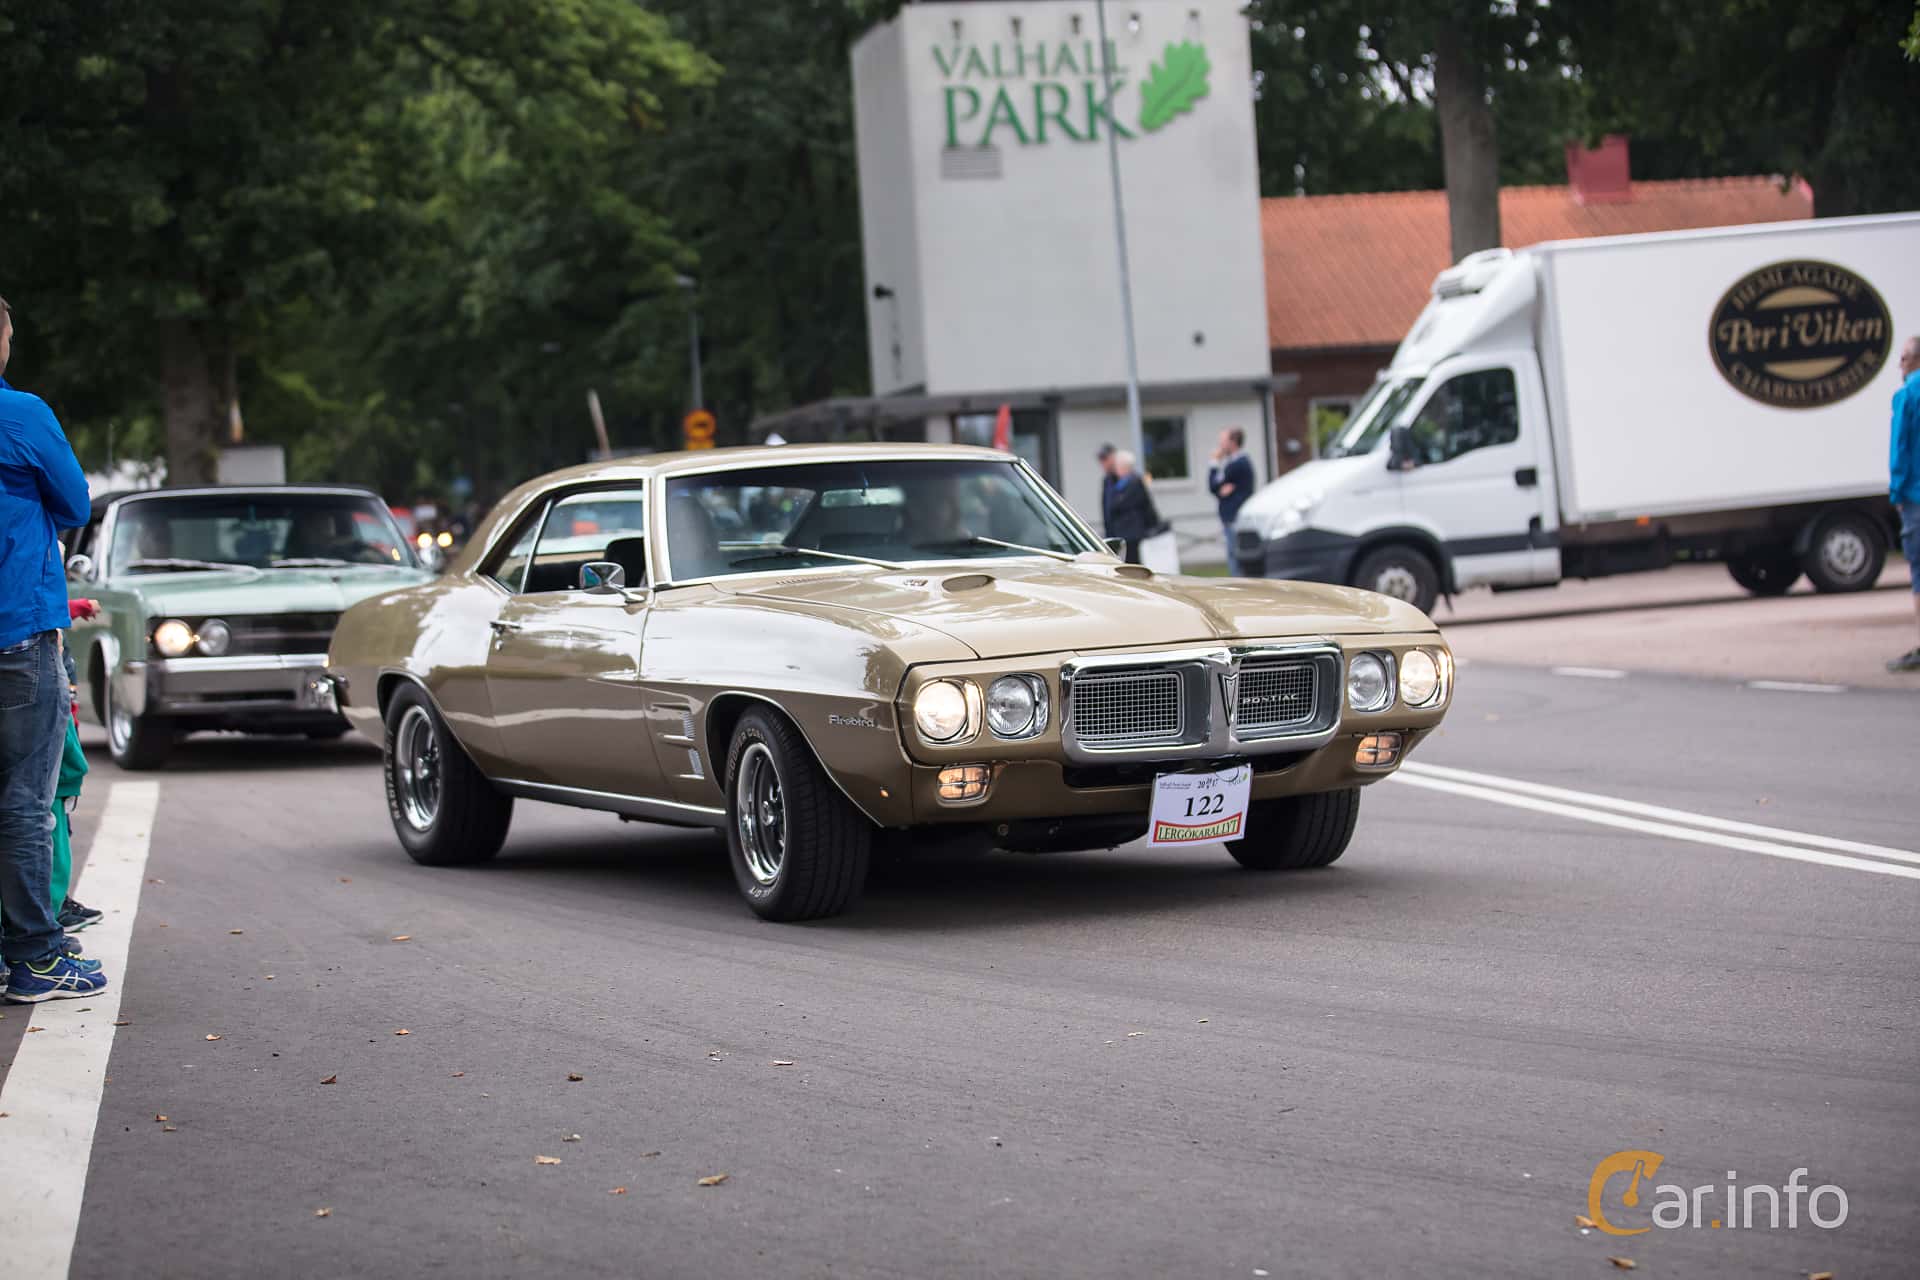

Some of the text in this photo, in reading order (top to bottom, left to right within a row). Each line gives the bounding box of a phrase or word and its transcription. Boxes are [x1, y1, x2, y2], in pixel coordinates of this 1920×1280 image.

[931, 39, 1129, 79] VALHALL
[942, 79, 1139, 149] PARK
[1718, 308, 1883, 354] Per i Viken
[1242, 693, 1298, 705] PONTIAC
[828, 713, 875, 728] Firebird
[1183, 793, 1225, 818] 122
